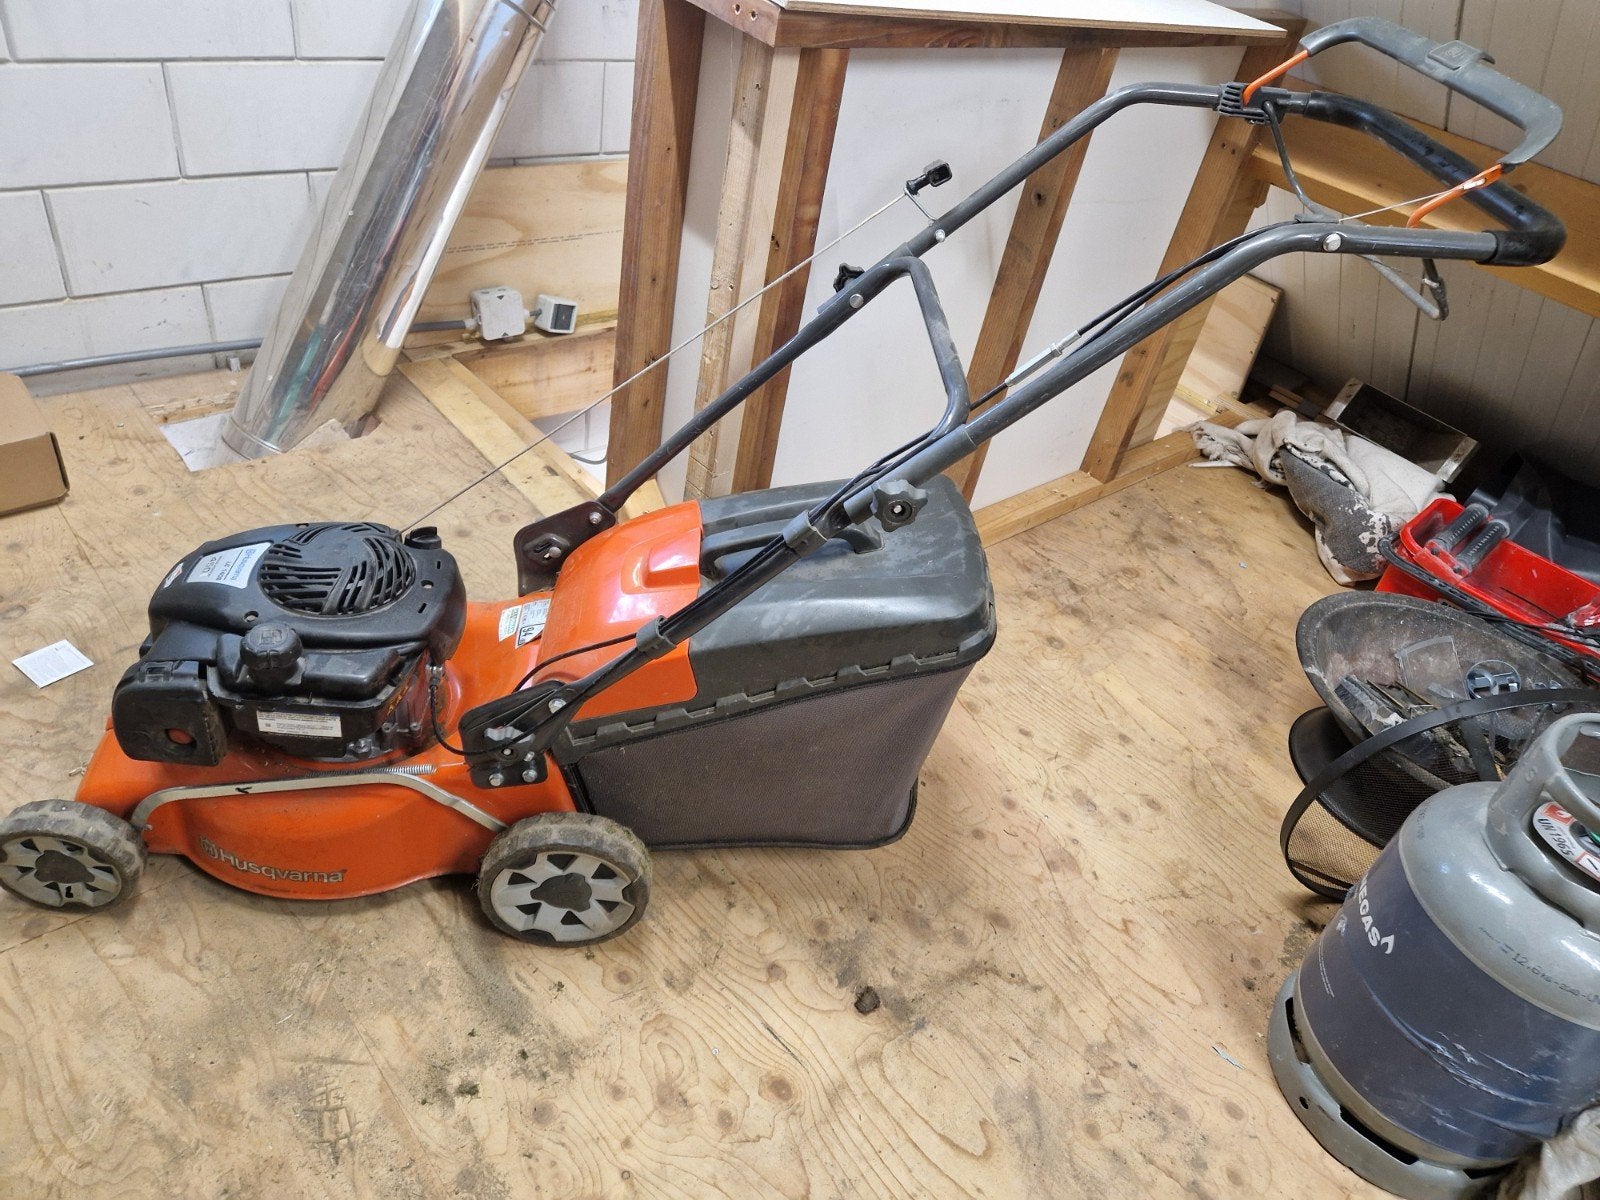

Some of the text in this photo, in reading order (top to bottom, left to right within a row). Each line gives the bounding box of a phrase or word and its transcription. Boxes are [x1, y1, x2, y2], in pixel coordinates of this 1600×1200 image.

[1537, 818, 1575, 856] UN 1965
[219, 848, 344, 883] Husqvarna
